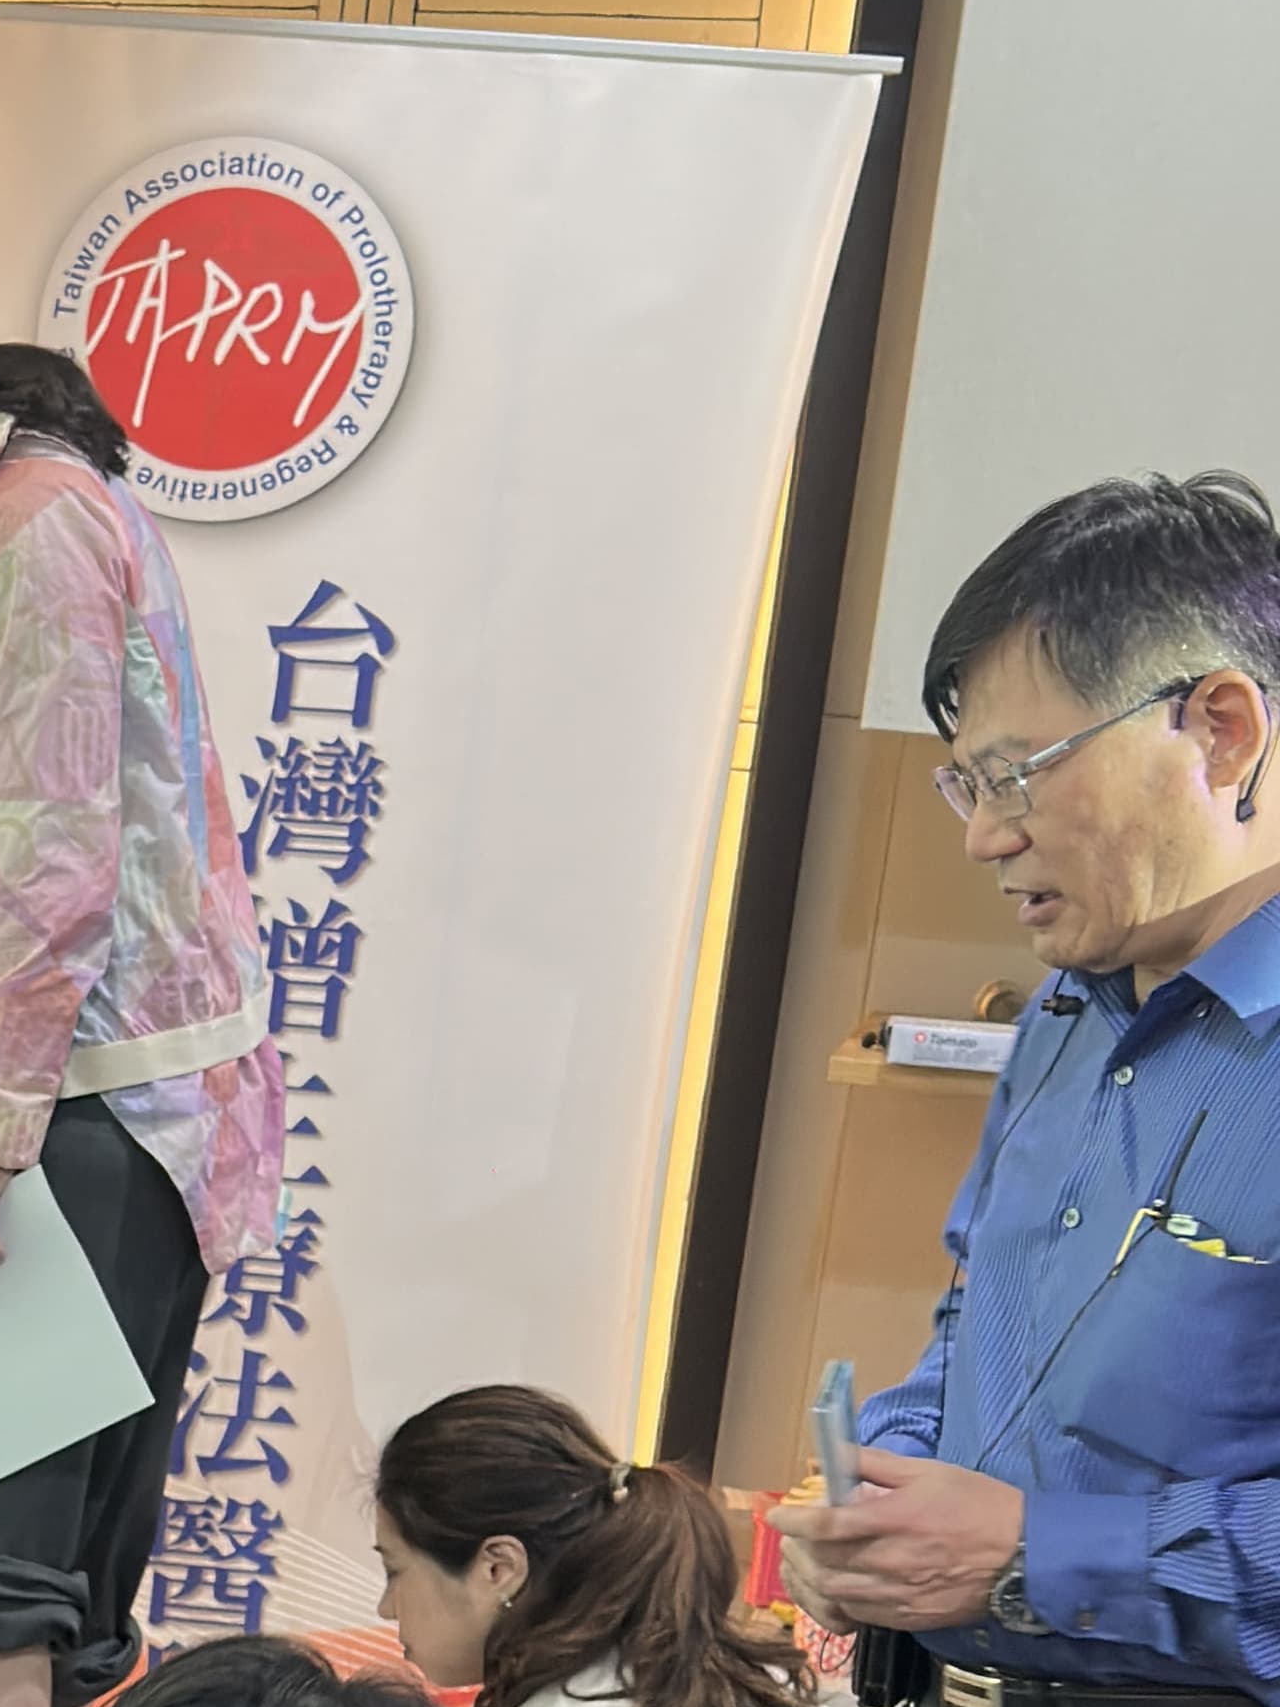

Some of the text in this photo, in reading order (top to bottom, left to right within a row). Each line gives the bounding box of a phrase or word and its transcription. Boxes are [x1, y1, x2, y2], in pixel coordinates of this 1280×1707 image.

[54, 150, 395, 502] Taiwan Association of Prolotherapy & Regenerative
